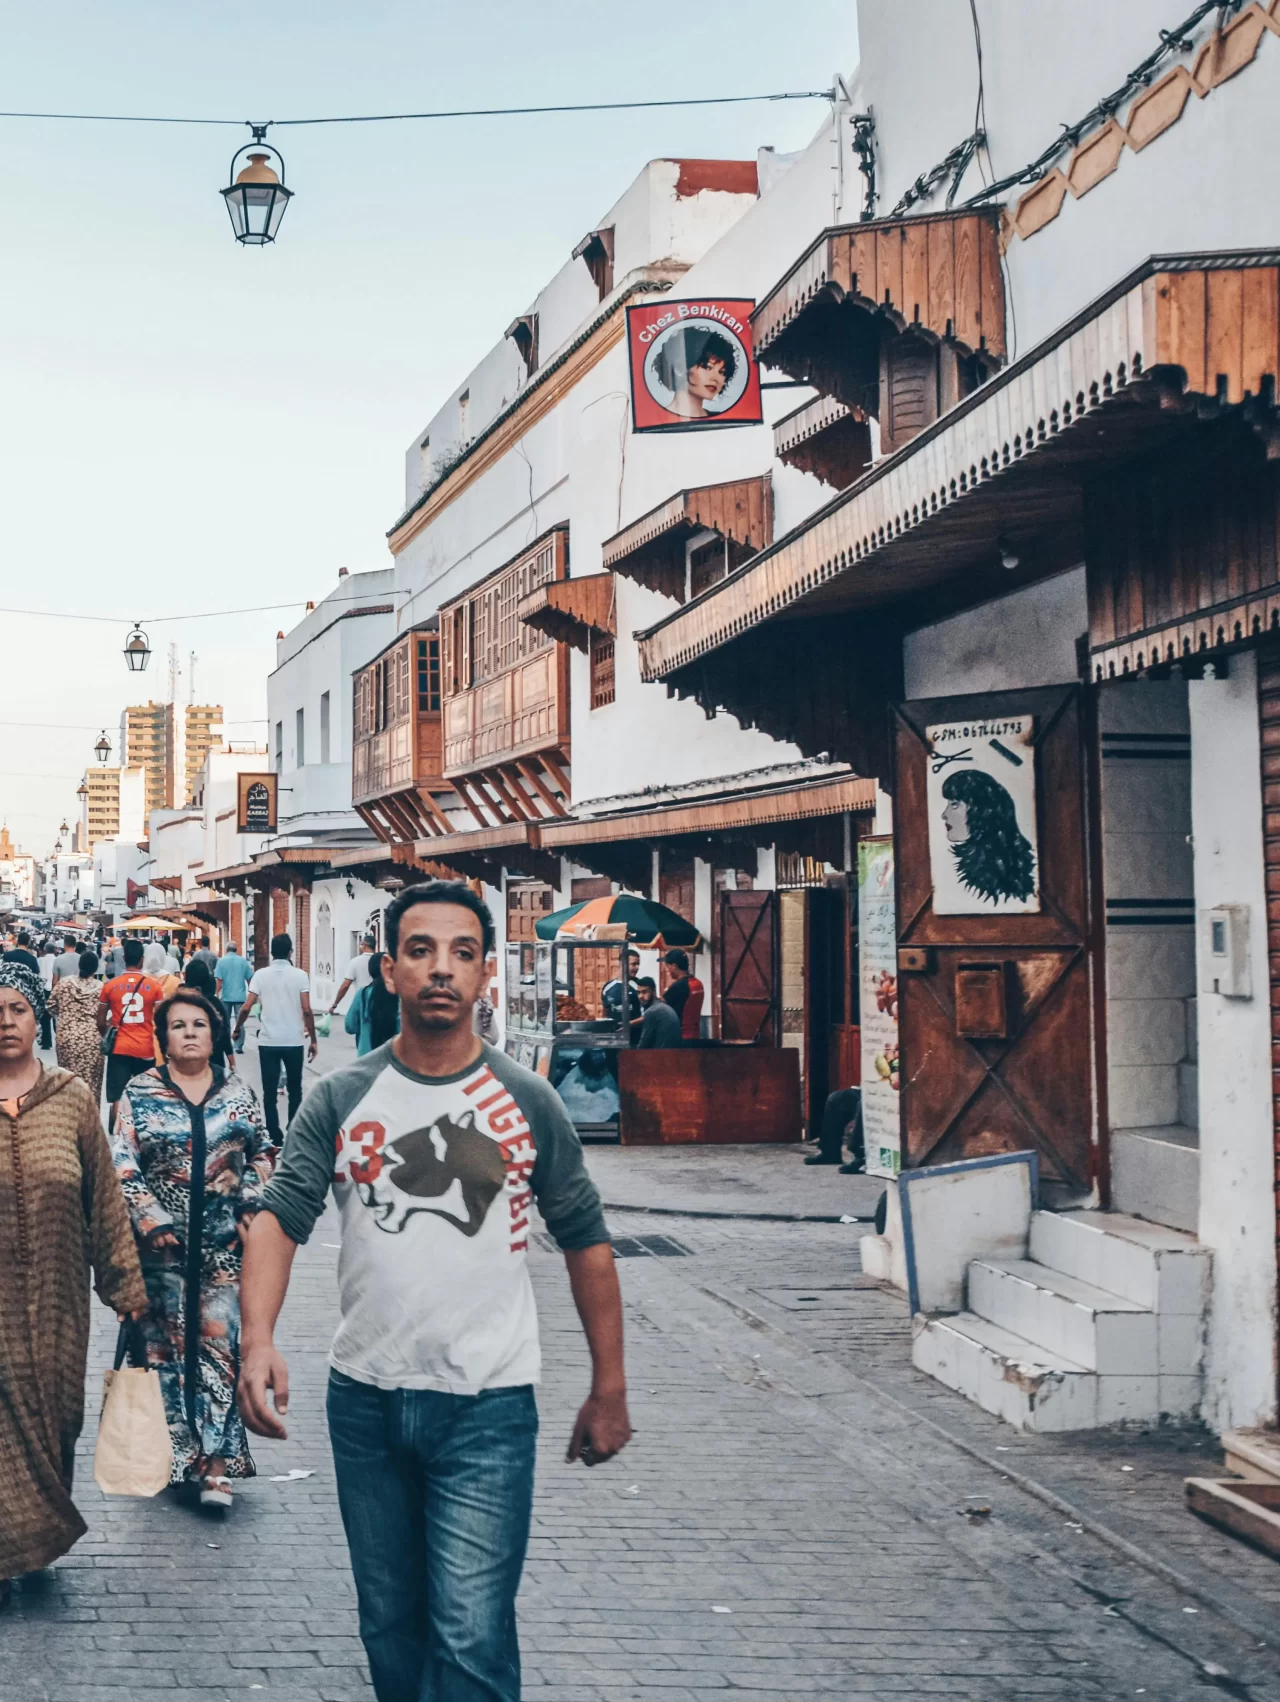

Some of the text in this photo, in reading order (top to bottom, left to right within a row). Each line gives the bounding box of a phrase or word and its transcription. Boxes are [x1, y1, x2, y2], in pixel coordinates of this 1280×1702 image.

[638, 304, 744, 343] Chez Benkiran
[121, 993, 145, 1023] 2
